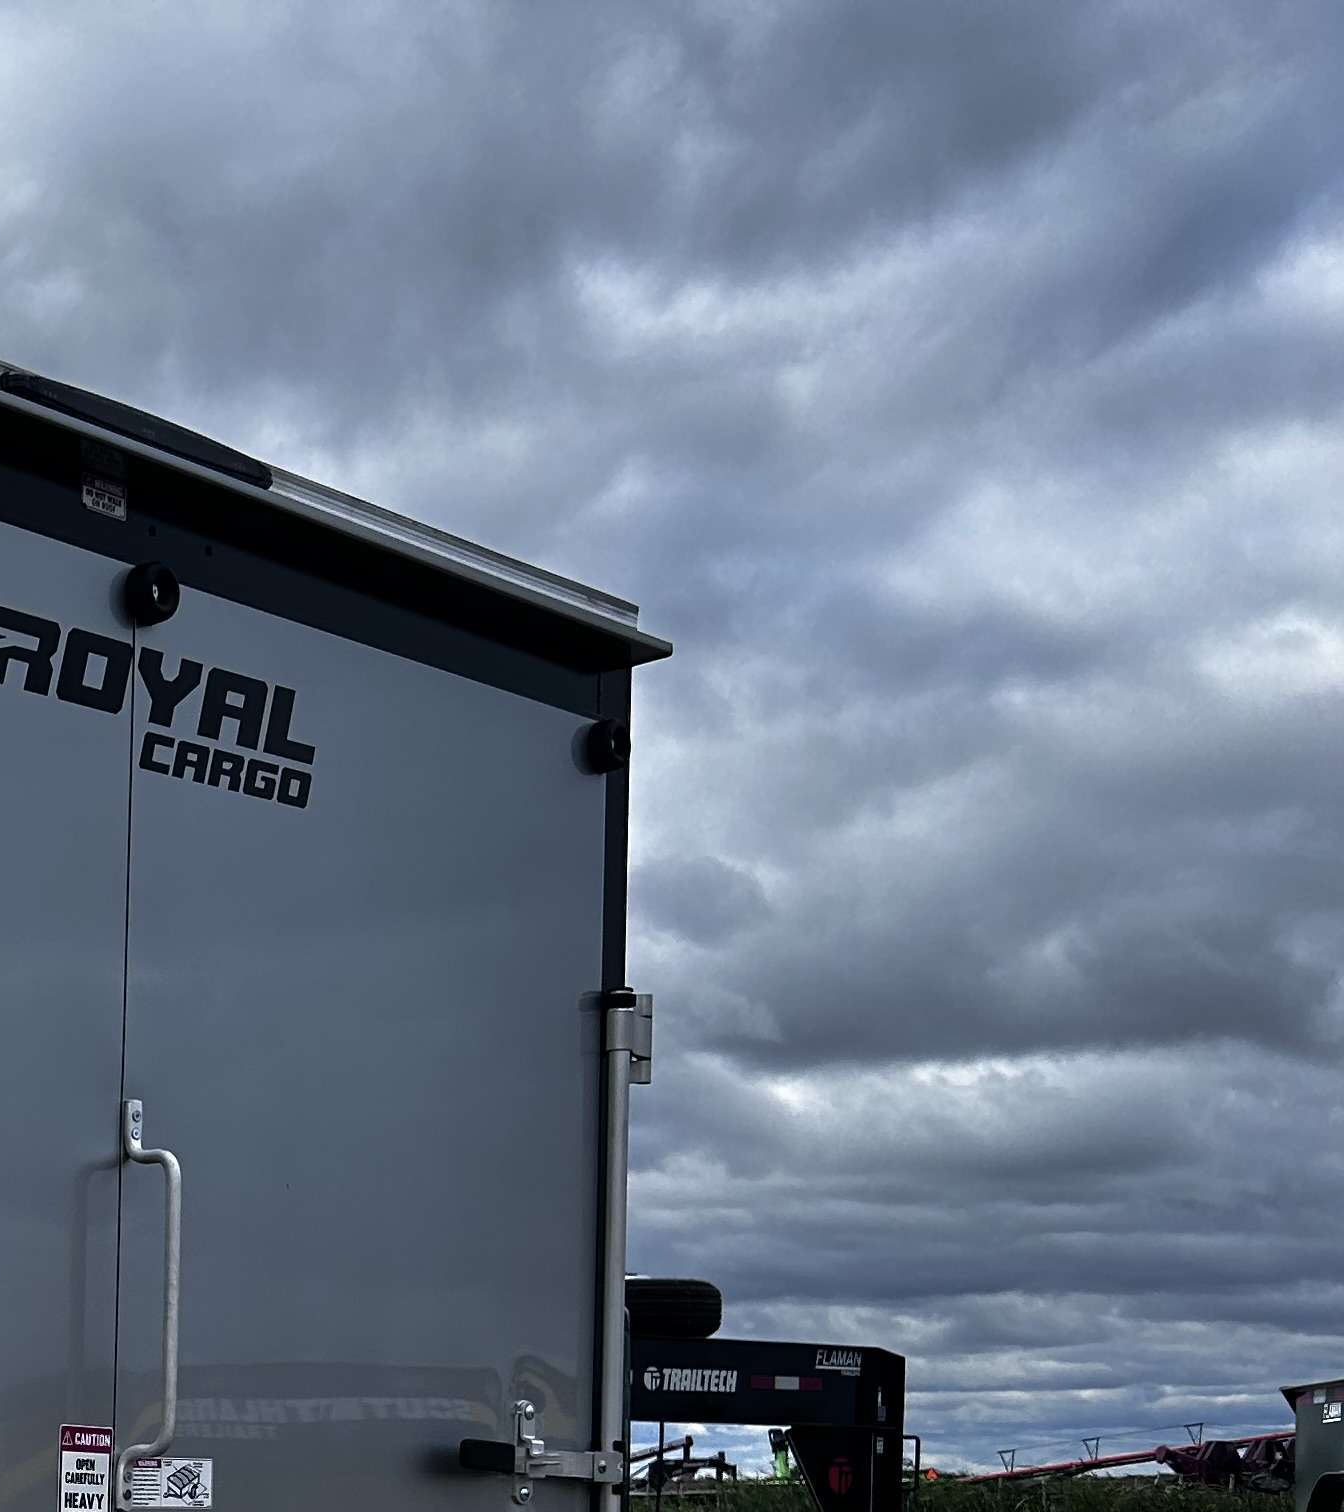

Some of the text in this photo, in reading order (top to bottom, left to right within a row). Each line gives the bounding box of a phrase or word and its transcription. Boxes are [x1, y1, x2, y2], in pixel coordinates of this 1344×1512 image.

[138, 731, 313, 809] CARGO
[815, 1348, 862, 1368] FLAMAN
[662, 1370, 738, 1393] TRAILTECH
[74, 1432, 111, 1448] CAUTION
[75, 1458, 96, 1472] OPEN
[64, 1471, 105, 1486] CAREFULLY
[64, 1492, 105, 1510] HEAVY
